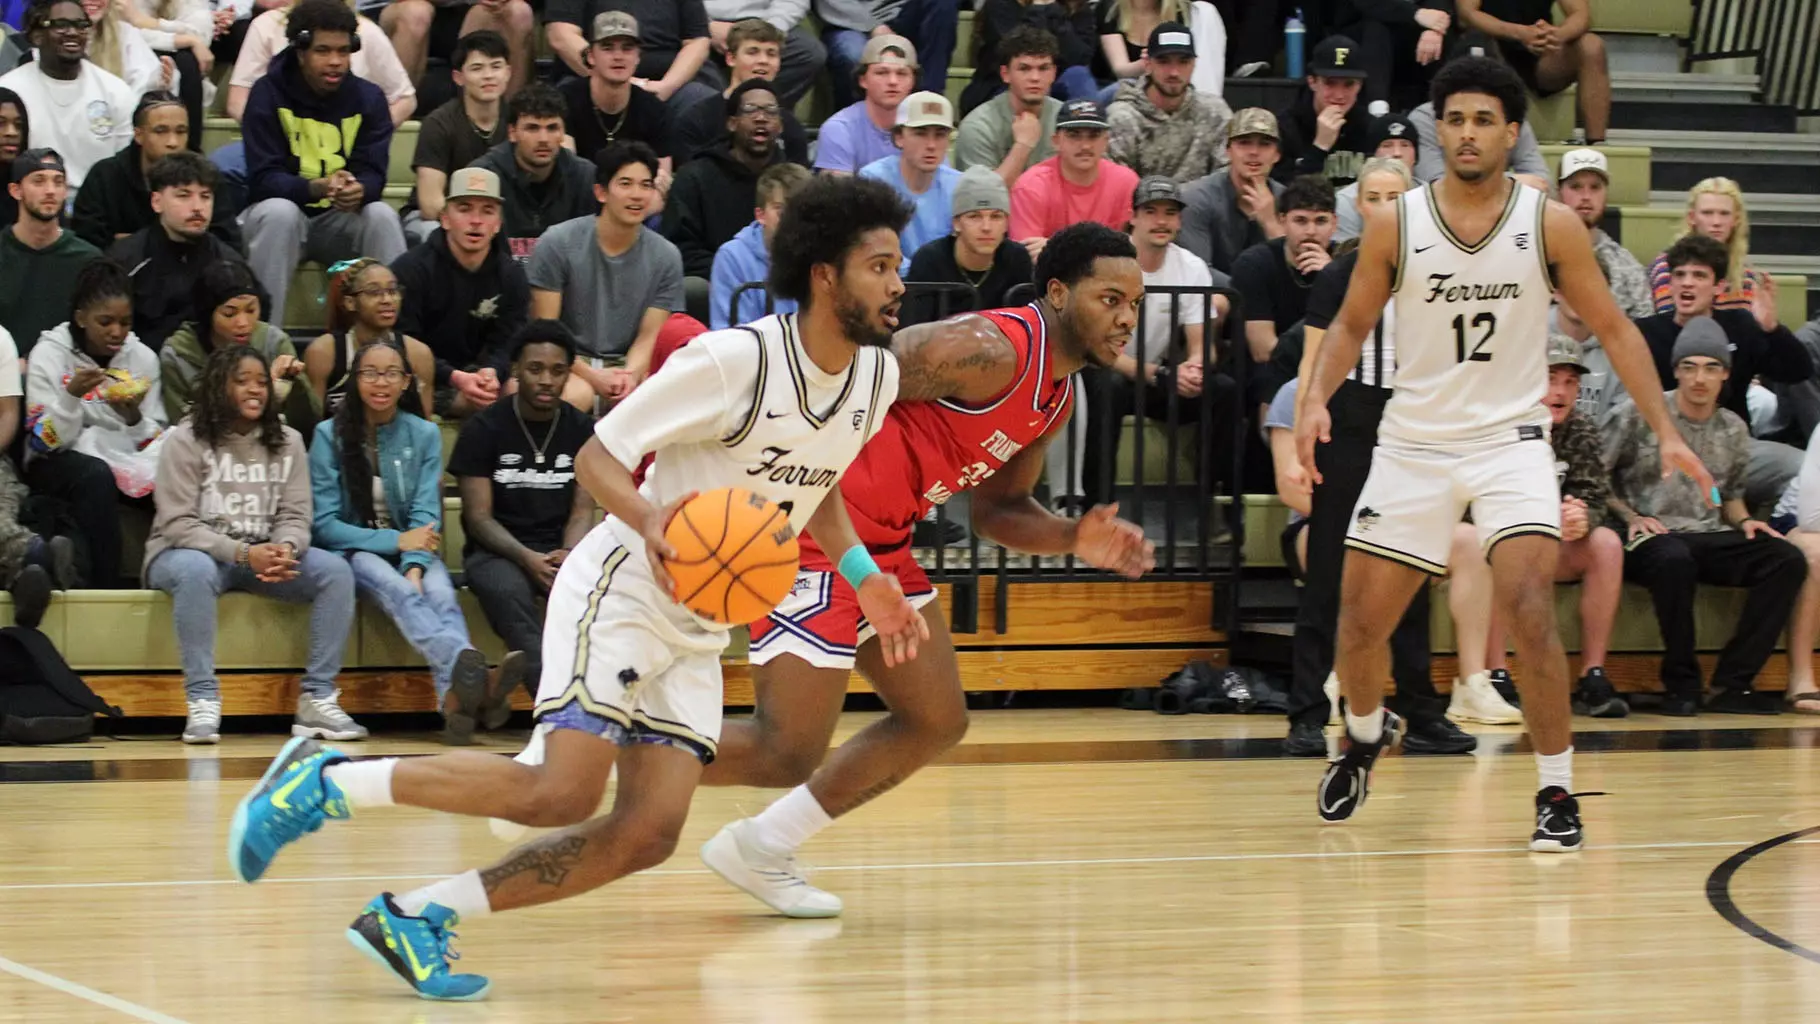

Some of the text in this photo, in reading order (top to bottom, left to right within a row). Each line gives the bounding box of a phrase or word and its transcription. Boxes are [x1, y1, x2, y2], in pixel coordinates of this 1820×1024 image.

[1335, 48, 1350, 65] F
[1425, 272, 1522, 303] Ferrum
[1452, 312, 1496, 363] 12
[202, 450, 293, 483] Menal
